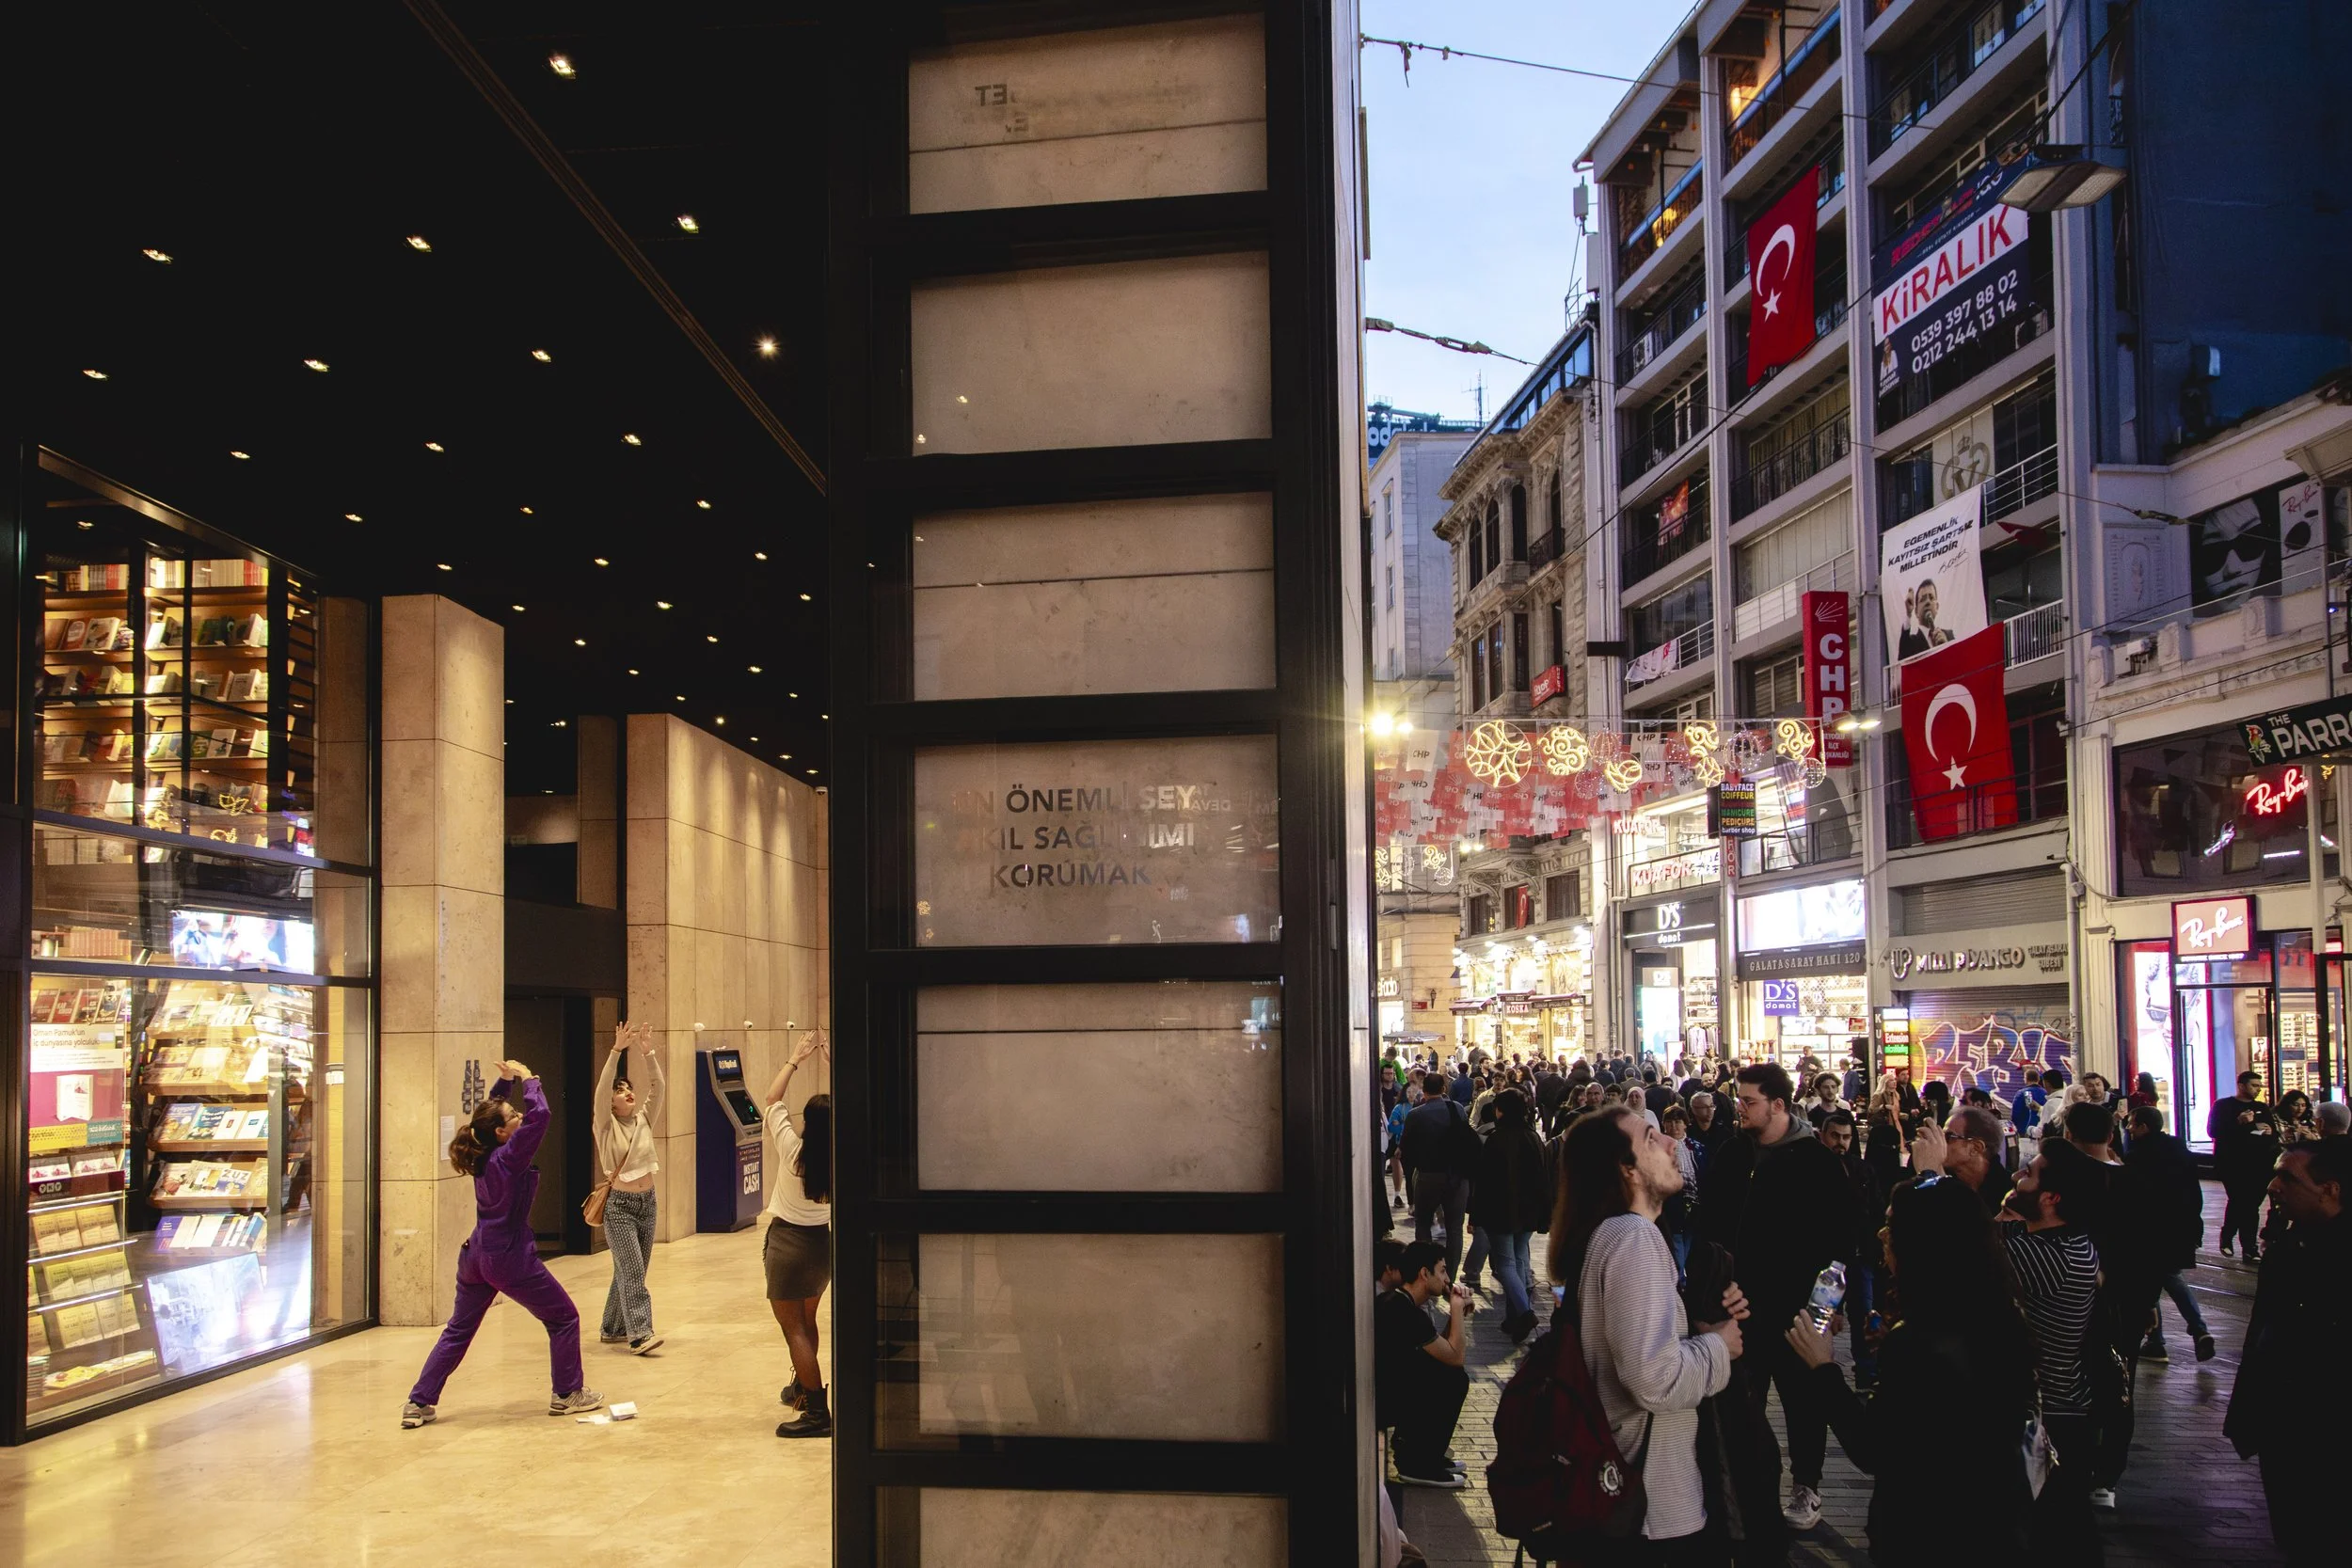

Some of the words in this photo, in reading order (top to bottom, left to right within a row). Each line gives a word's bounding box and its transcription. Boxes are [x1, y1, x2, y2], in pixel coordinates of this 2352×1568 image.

[1911, 320, 1942, 352] 0539
[1946, 299, 1970, 331] 397
[1977, 285, 1994, 309] 88
[1998, 269, 2018, 293] 02
[1913, 341, 1942, 373] 0212
[1946, 322, 1978, 353] 244
[1979, 307, 1995, 332] 13
[1998, 293, 2017, 319] 14
[1820, 632, 1845, 726] CHP
[2267, 714, 2291, 727] THE
[2272, 710, 2352, 758] PARR
[1413, 750, 1430, 758] CHP
[1721, 791, 1754, 800] COIFFEUR
[1722, 817, 1755, 826] PEDICURE
[992, 862, 1152, 889] KORUMAK
[1750, 957, 1813, 972] GALATASARAY
[1844, 952, 1861, 964] 120
[1765, 983, 1797, 1000] D'S
[1506, 1004, 1529, 1014] KOSKA
[1765, 1001, 1797, 1009] damat
[743, 1173, 760, 1195] CASH
